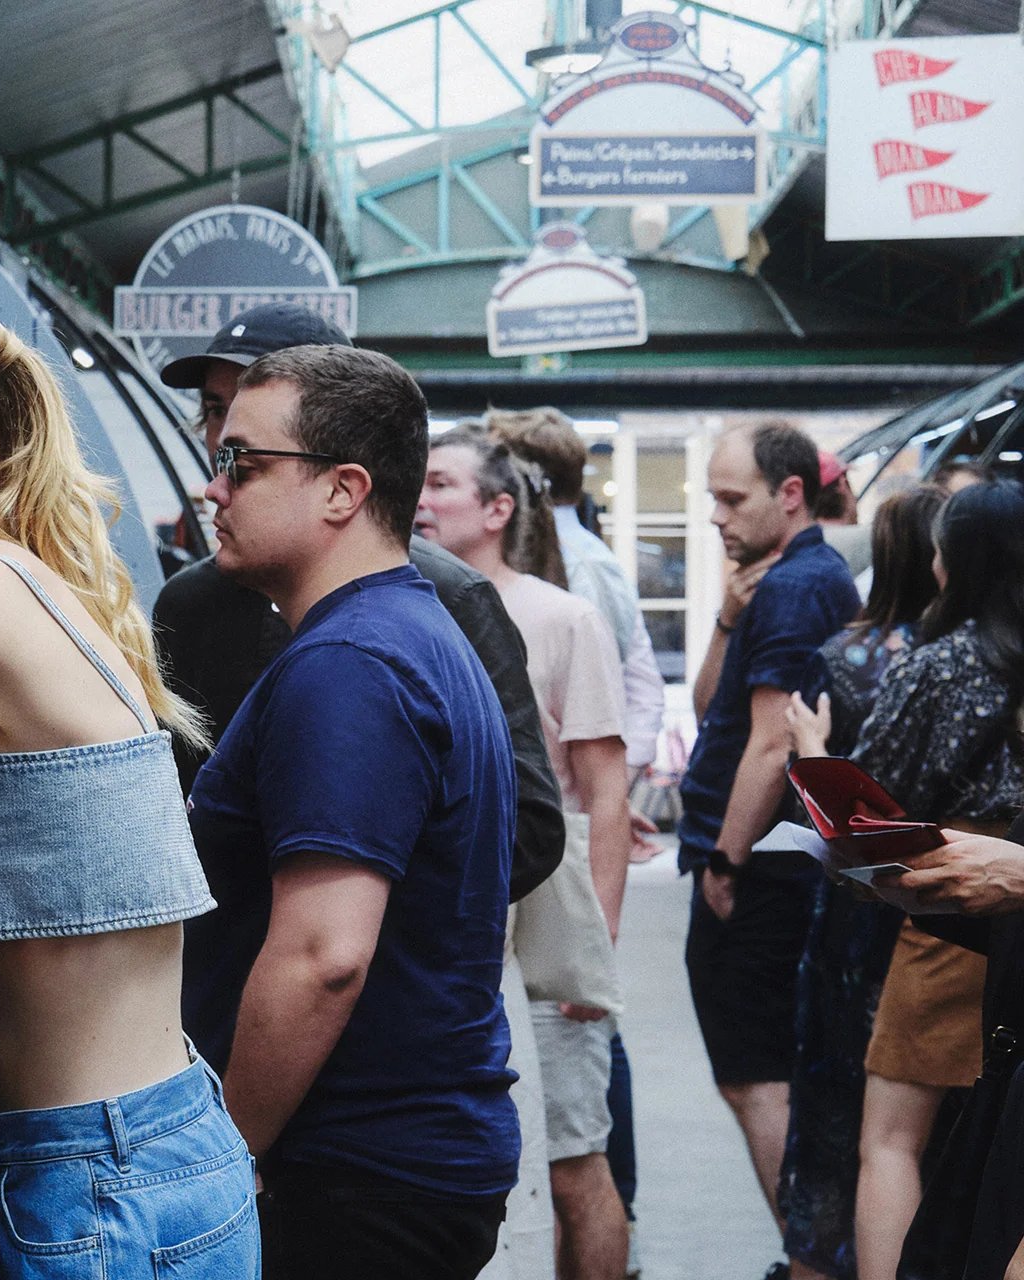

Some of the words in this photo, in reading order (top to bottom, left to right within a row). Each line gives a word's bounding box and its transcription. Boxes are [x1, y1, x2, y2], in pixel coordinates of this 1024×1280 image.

[876, 51, 926, 83] CHEZ
[914, 92, 966, 127] ALAIN
[877, 143, 928, 176] MIAM
[557, 165, 621, 188] Burgers
[911, 185, 964, 218] MIAM
[149, 249, 175, 279] LE
[121, 293, 222, 331] BURGER
